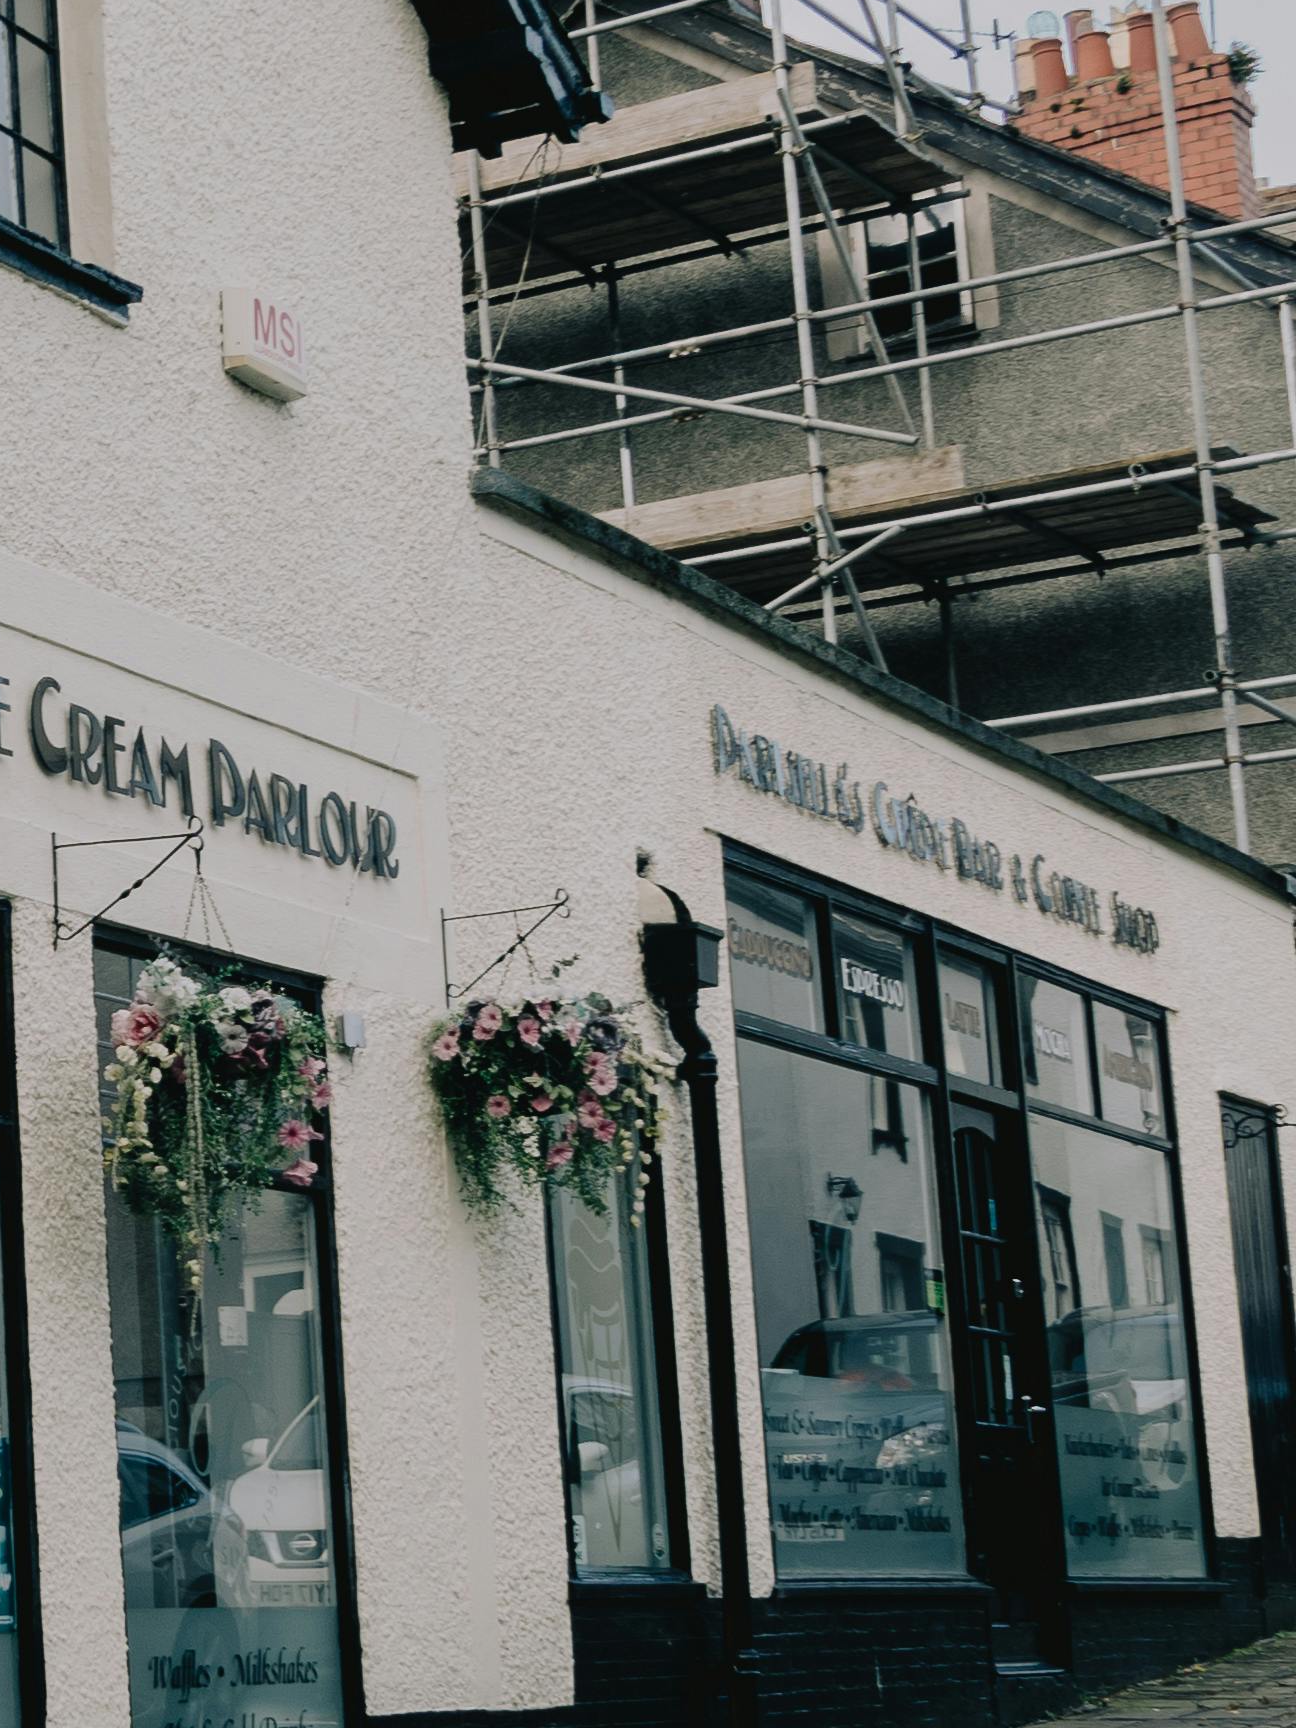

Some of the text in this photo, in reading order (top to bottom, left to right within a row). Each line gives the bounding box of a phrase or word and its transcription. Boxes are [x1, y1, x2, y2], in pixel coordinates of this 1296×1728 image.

[31, 677, 193, 816] CREAM
[209, 738, 398, 878] PARLOUR
[841, 958, 904, 1010] ESPRESSO
[230, 1646, 319, 1687] Milkshakes
